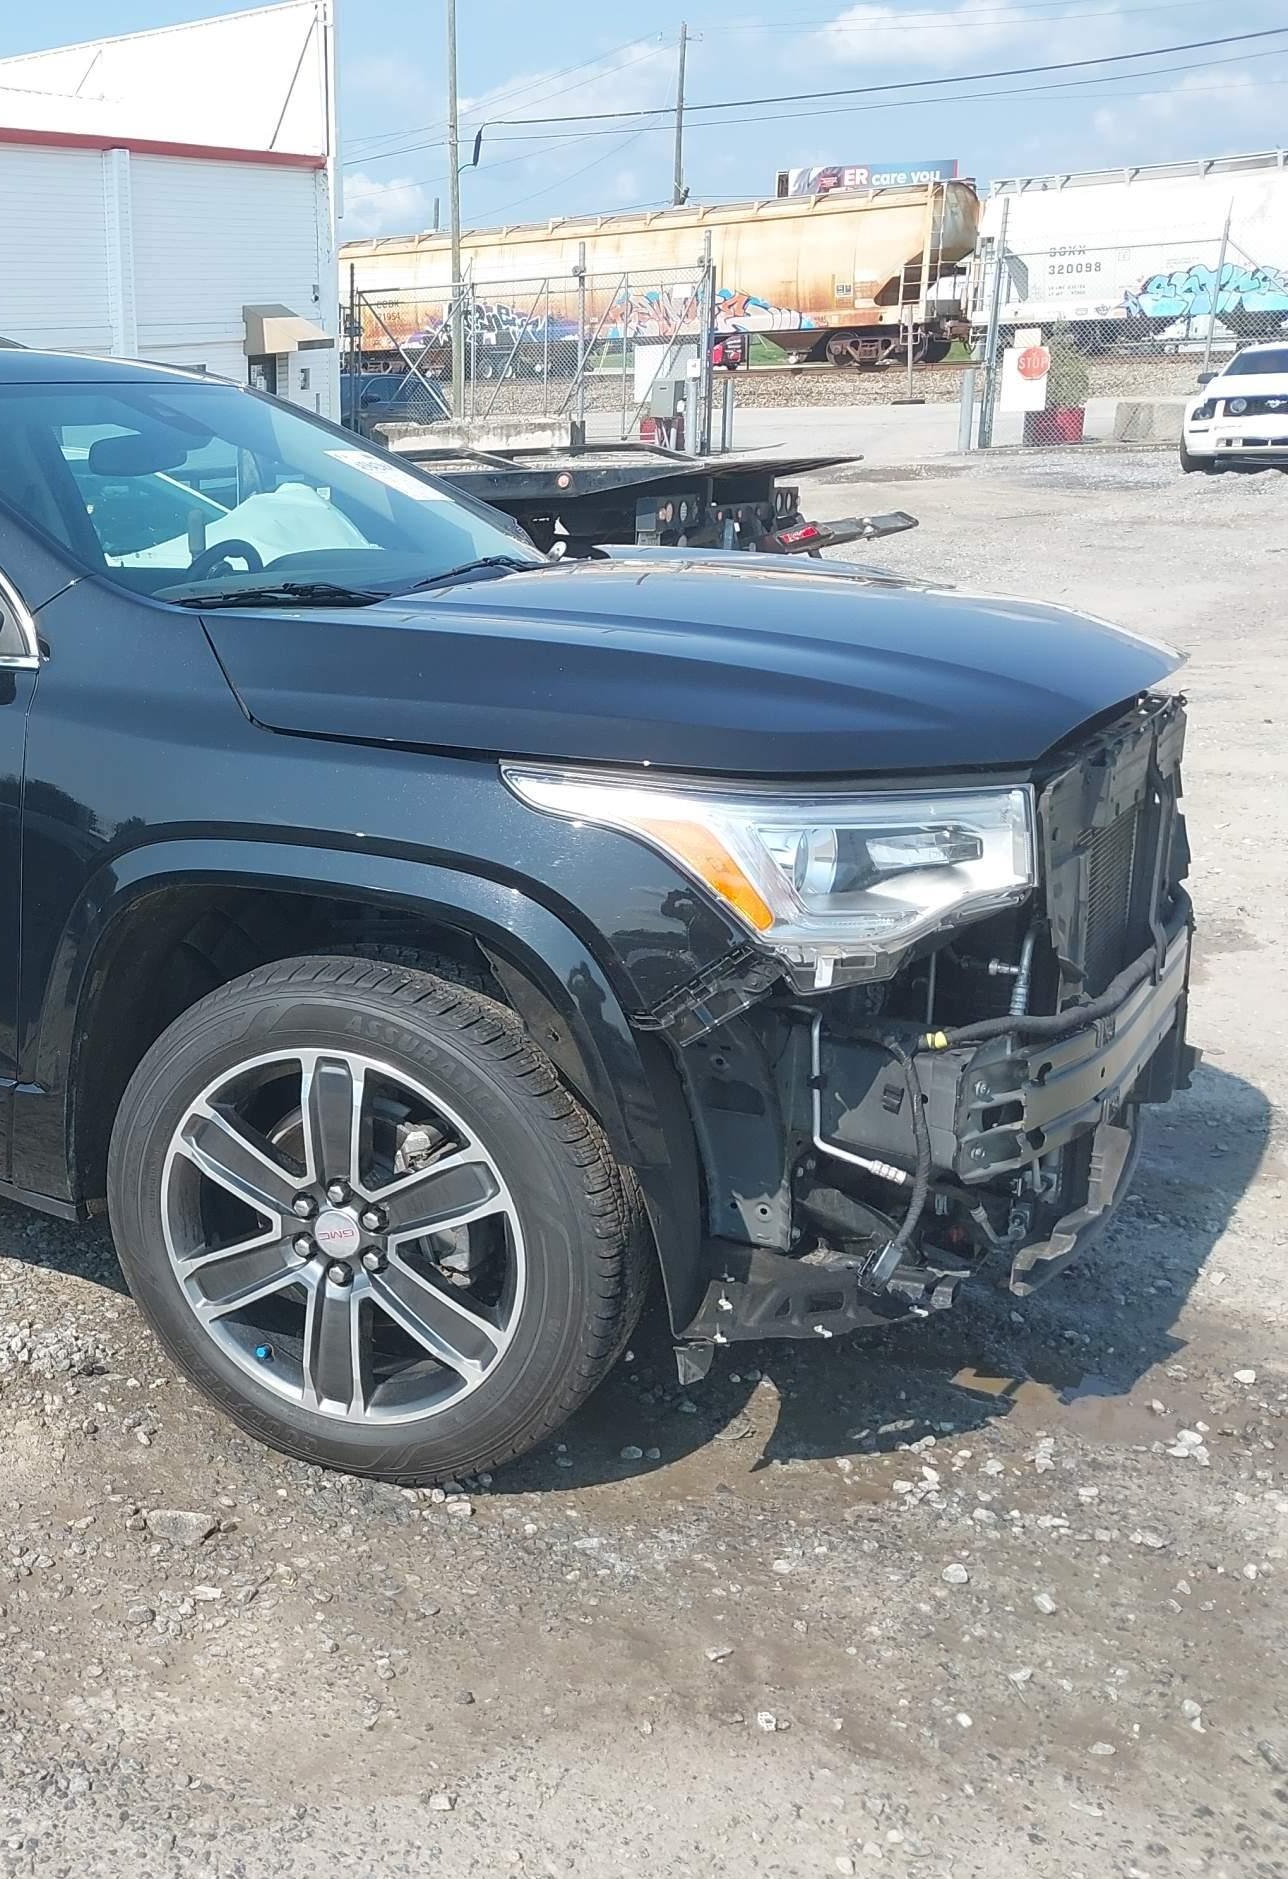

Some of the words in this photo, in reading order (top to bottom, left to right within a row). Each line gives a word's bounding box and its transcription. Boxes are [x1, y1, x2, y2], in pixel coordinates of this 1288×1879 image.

[844, 168, 868, 186] ER
[871, 171, 906, 186] care
[911, 169, 941, 183] you
[1048, 262, 1102, 275] 320098
[1019, 356, 1048, 369] STOP
[318, 1227, 354, 1241] GMC
